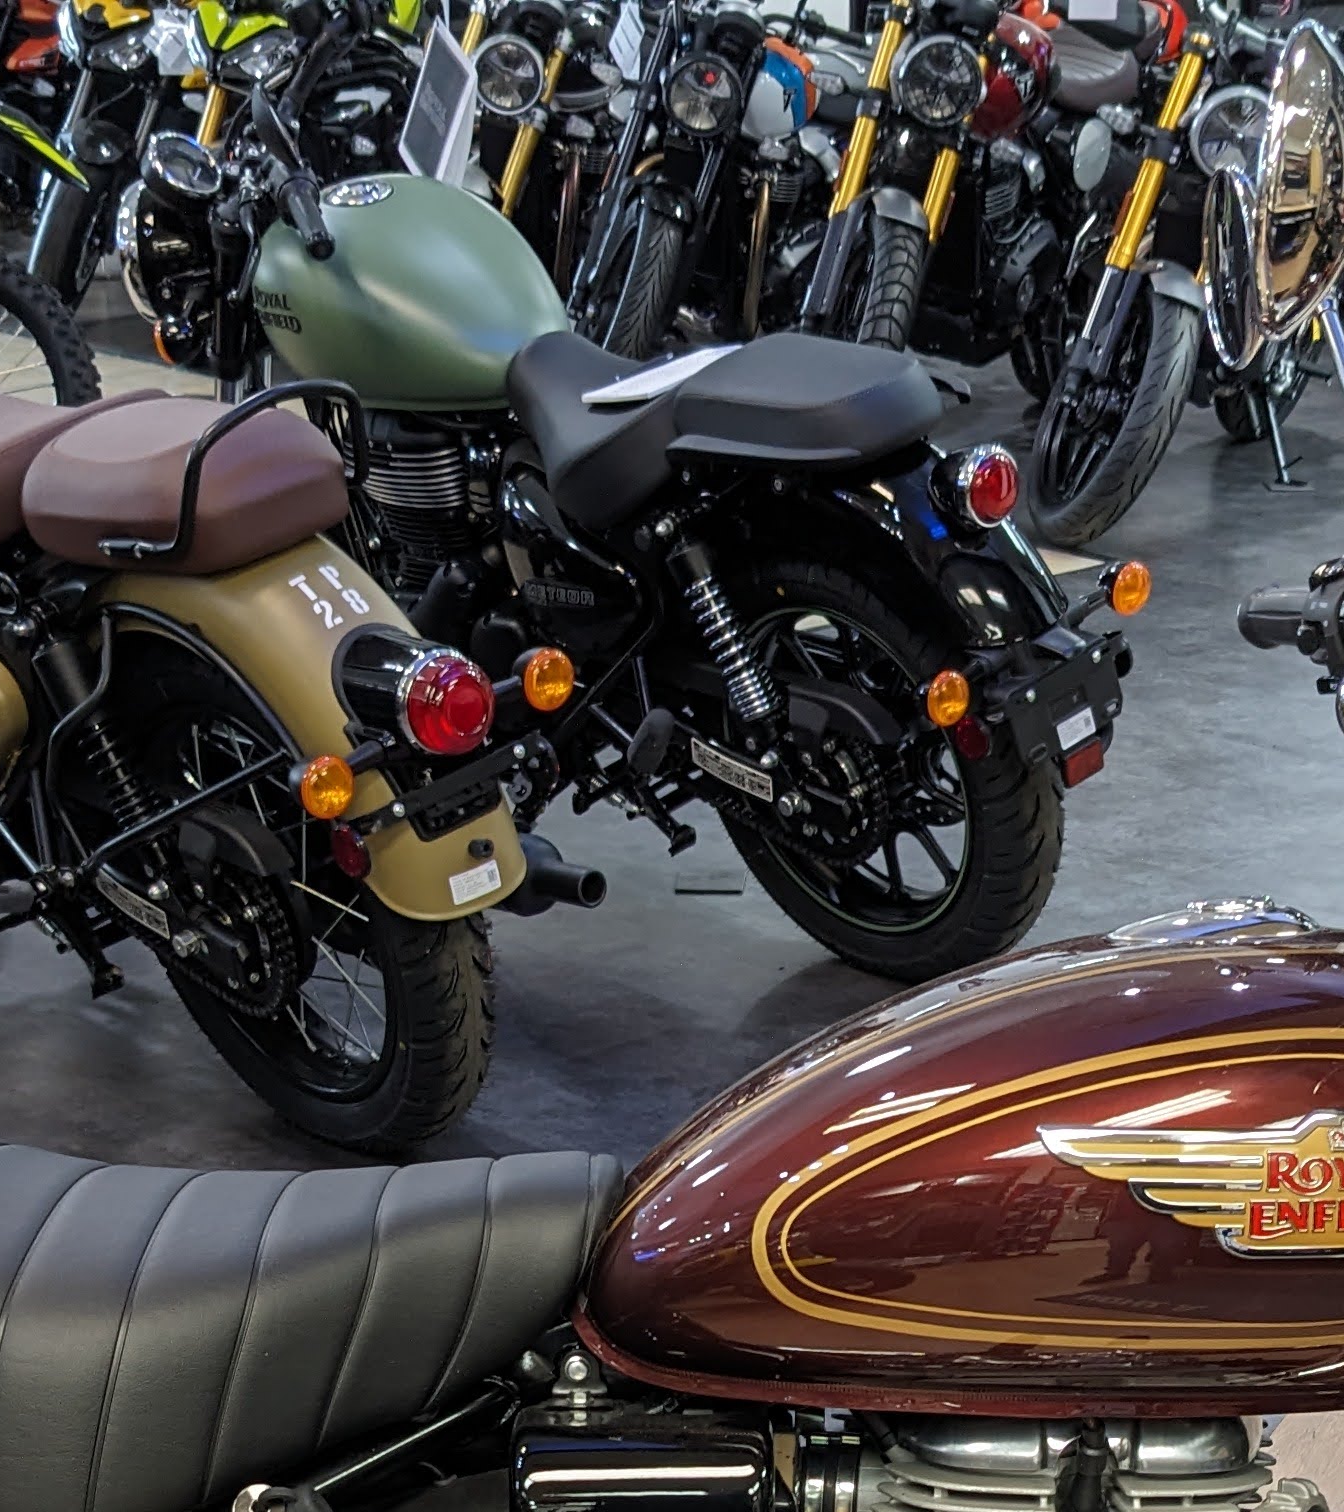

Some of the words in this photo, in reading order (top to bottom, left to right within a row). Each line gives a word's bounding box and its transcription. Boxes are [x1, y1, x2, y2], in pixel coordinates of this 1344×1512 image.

[288, 574, 317, 601] T
[318, 565, 343, 590] P
[313, 600, 343, 629] 2
[341, 589, 370, 614] 8
